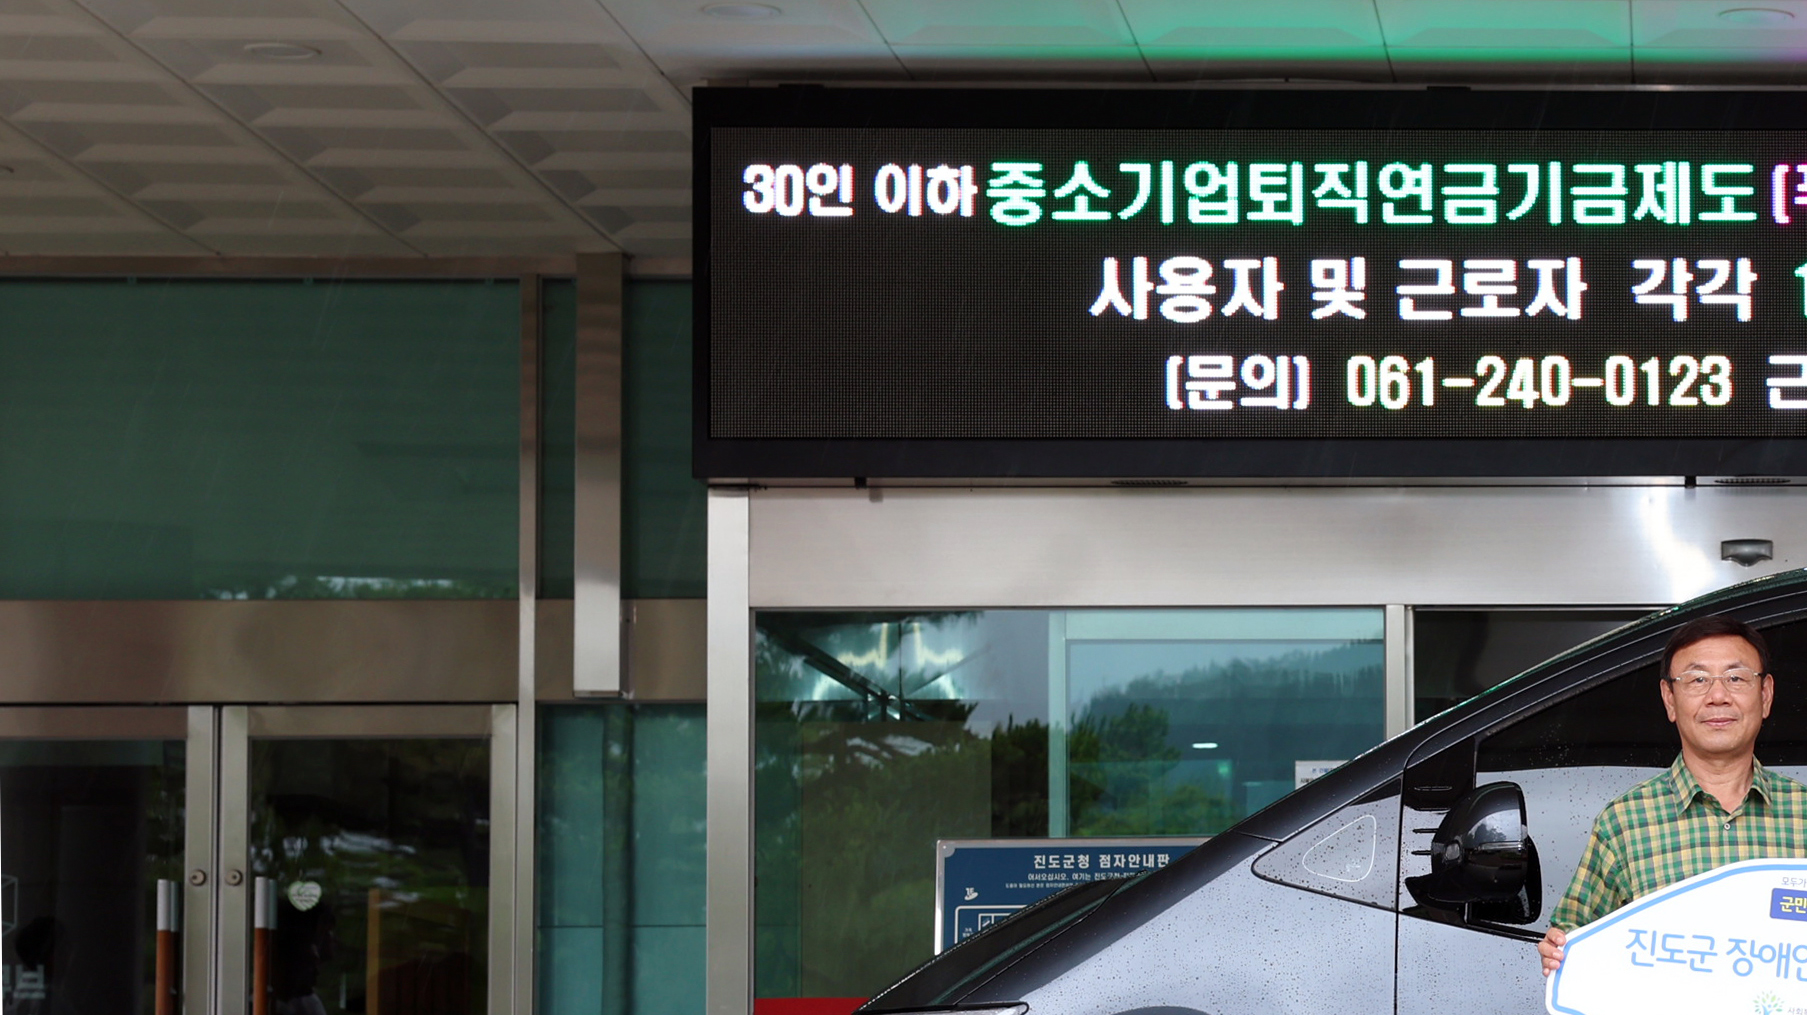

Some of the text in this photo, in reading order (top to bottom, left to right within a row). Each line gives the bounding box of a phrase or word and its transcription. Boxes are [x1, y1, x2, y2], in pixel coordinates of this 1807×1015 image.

[743, 162, 854, 217] 30인
[874, 162, 978, 218] 이하
[1088, 255, 1285, 324] 사용자
[1310, 256, 1367, 321] 및
[1395, 256, 1588, 321] 근로자
[1631, 257, 1759, 323] 각각
[1346, 354, 1733, 410] 061-240-0123
[1033, 853, 1170, 870] 진도군청 점자안내판
[1780, 876, 1807, 888] 모두가
[1624, 927, 1719, 974] 진도군
